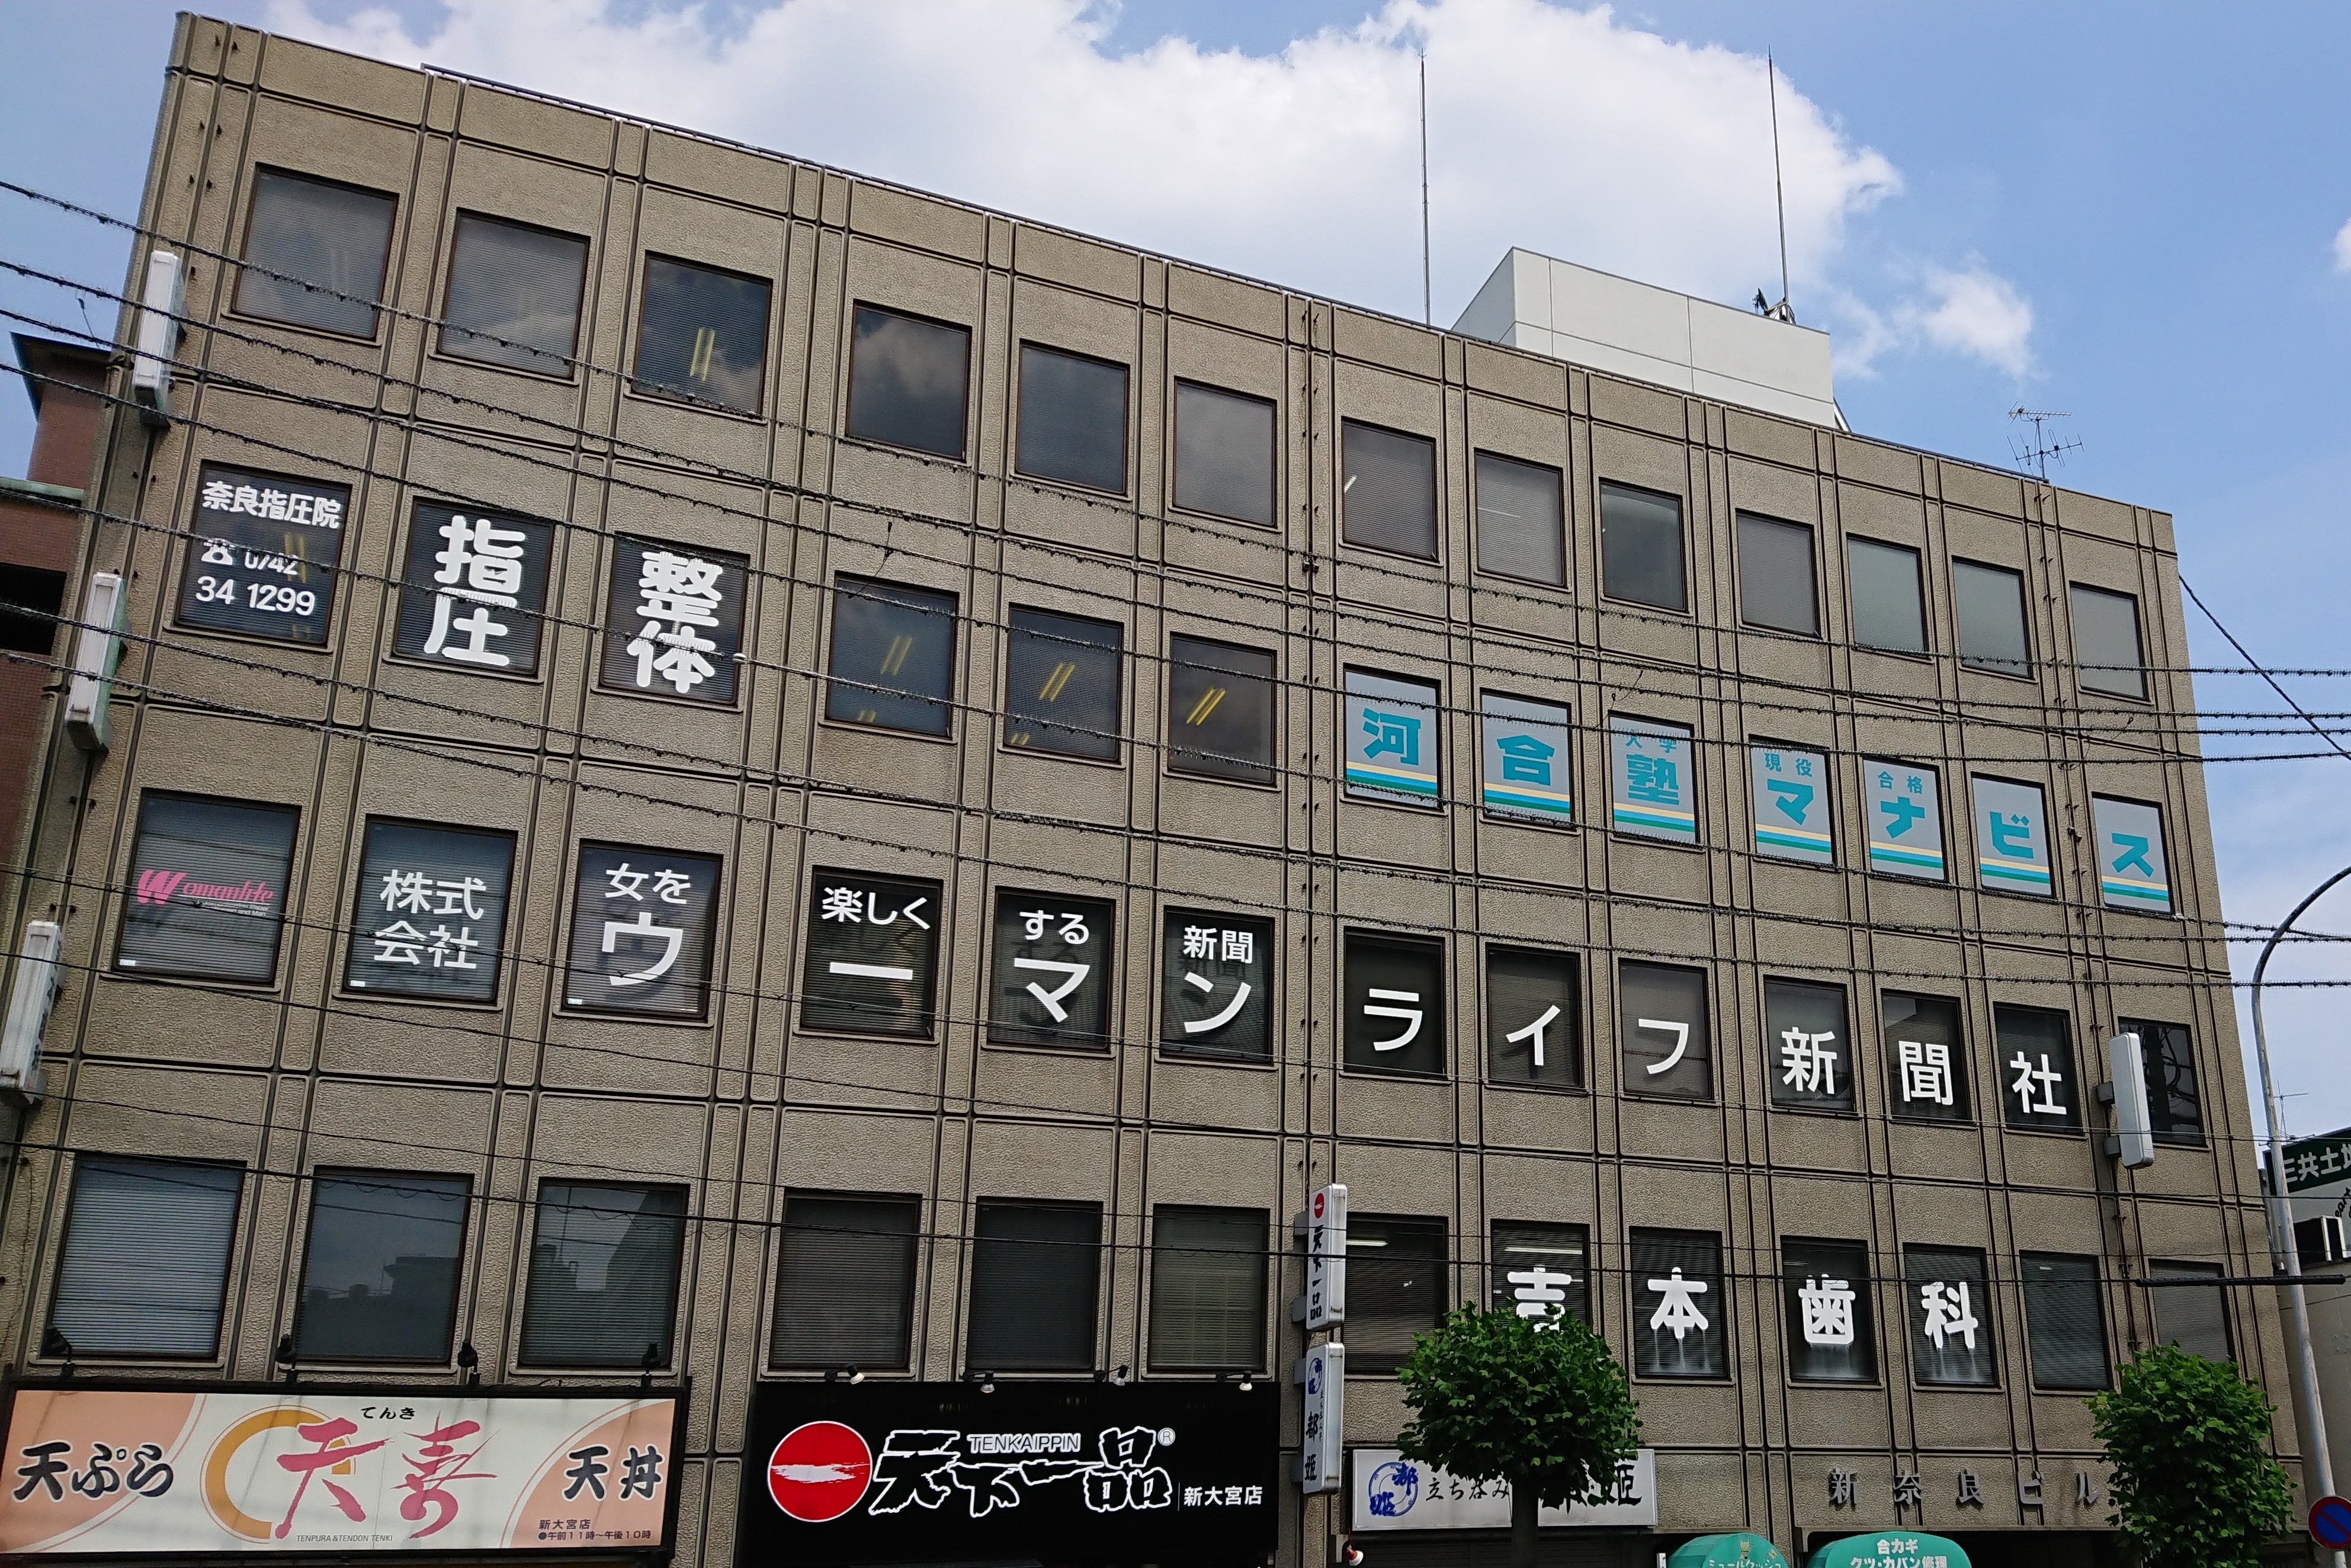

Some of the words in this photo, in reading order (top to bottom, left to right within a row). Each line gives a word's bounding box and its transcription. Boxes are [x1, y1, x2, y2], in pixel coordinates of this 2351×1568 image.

[202, 480, 341, 529] 奈良指圧院
[195, 576, 235, 605] 34
[247, 583, 316, 615] 1299
[424, 515, 525, 666] 指圧
[627, 551, 723, 694] 整体
[1765, 752, 1813, 778] 現役
[1878, 771, 1923, 794] 合格
[380, 869, 487, 920] 株式
[605, 862, 691, 905] 女を
[821, 887, 931, 930] 楽しく
[1019, 910, 1089, 945] する
[1183, 925, 1253, 964] 新聞
[374, 921, 479, 969] 会社
[360, 1406, 416, 1421] てんき
[967, 1433, 1081, 1454] TENKAIPPIN
[13, 1440, 174, 1502] 天ぷら
[562, 1444, 663, 1502] 天丼
[868, 1425, 1173, 1518] 天下一品
[1829, 1468, 2103, 1506] 新奈良ビル
[1184, 1485, 1263, 1506] 新大宮店
[539, 1519, 591, 1530] 新大宮店
[1877, 1538, 1919, 1554] 合カギ
